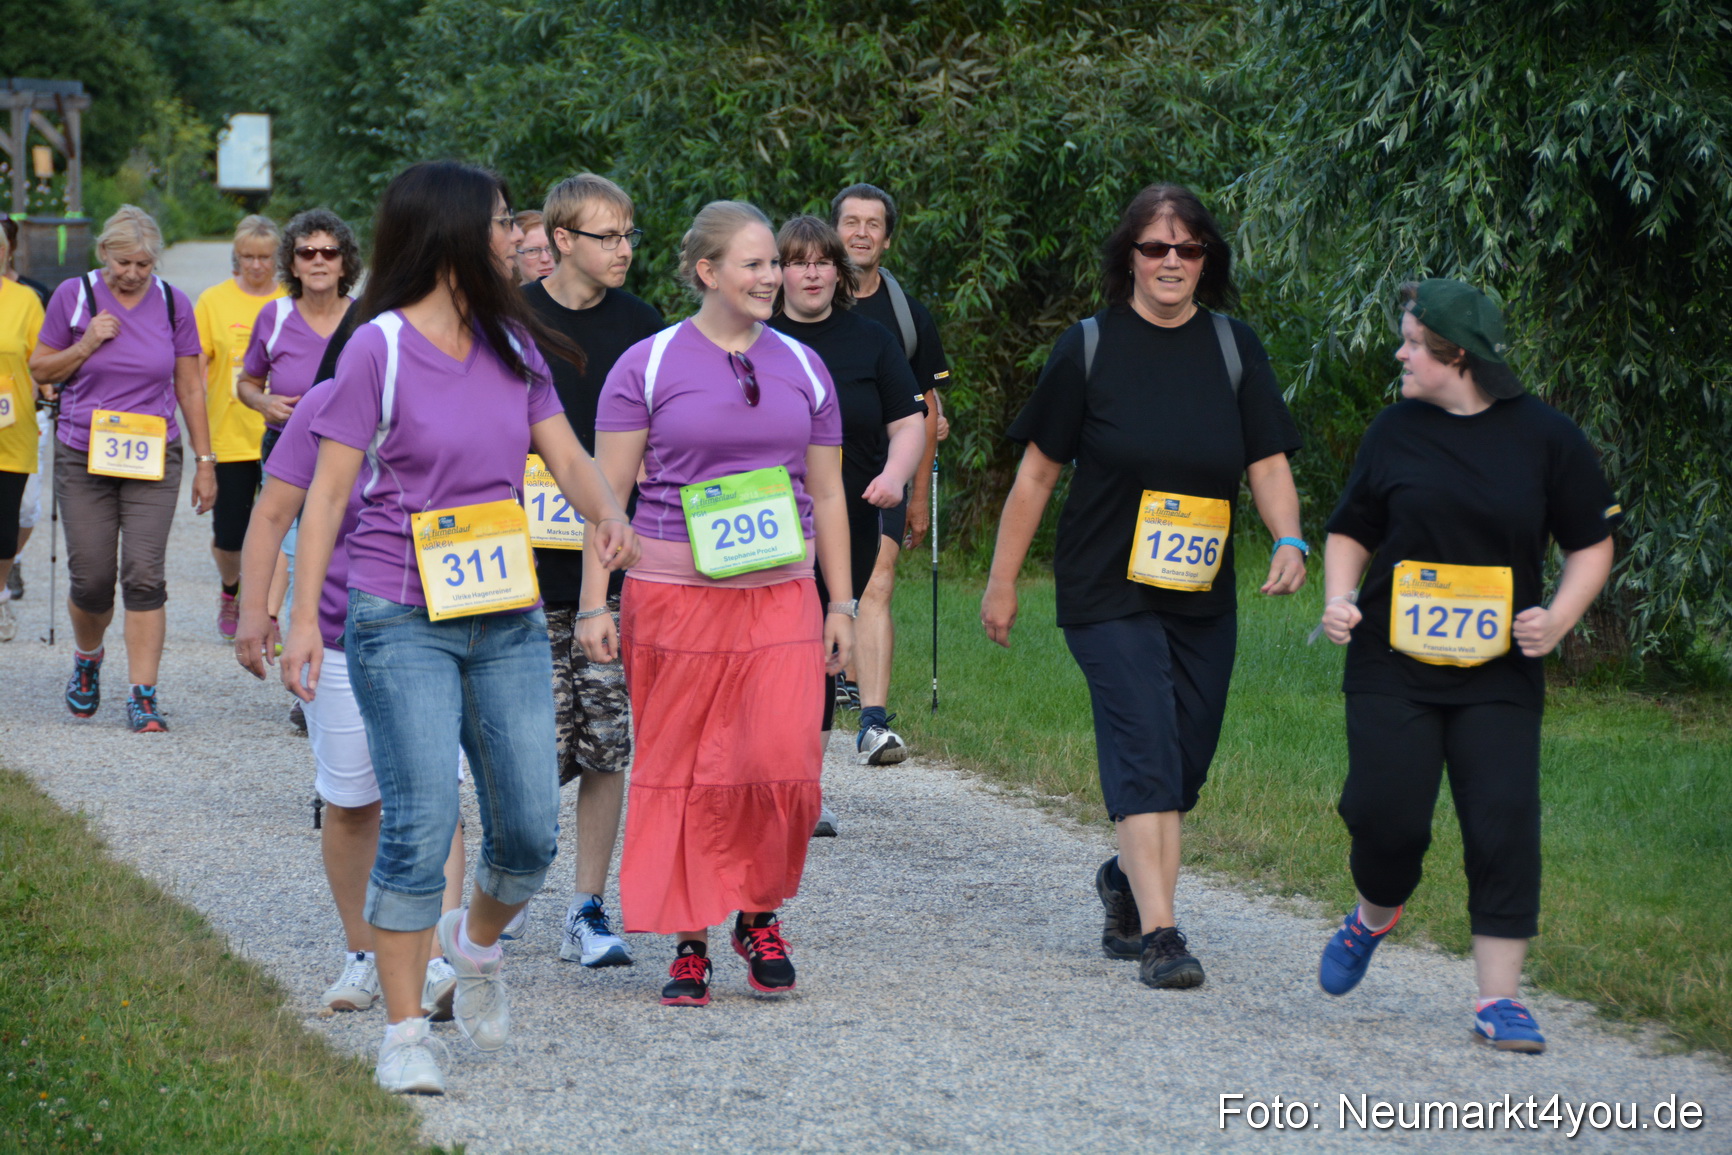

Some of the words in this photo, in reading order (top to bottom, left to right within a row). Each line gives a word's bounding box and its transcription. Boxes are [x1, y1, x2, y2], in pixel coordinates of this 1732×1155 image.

[105, 437, 149, 461] 319
[526, 479, 556, 488] walken
[1144, 516, 1173, 527] walken
[432, 523, 471, 537] firmenlauf
[546, 528, 570, 536] Markus
[711, 509, 779, 551] 296
[422, 540, 455, 551] walken
[1146, 530, 1219, 567] 1256
[723, 551, 756, 562] Stephanie
[442, 545, 508, 587] 311
[1161, 567, 1185, 576] Barbara
[452, 591, 472, 601] Ulrike
[472, 587, 512, 599] Hagenreiner
[1405, 604, 1498, 640] 1276
